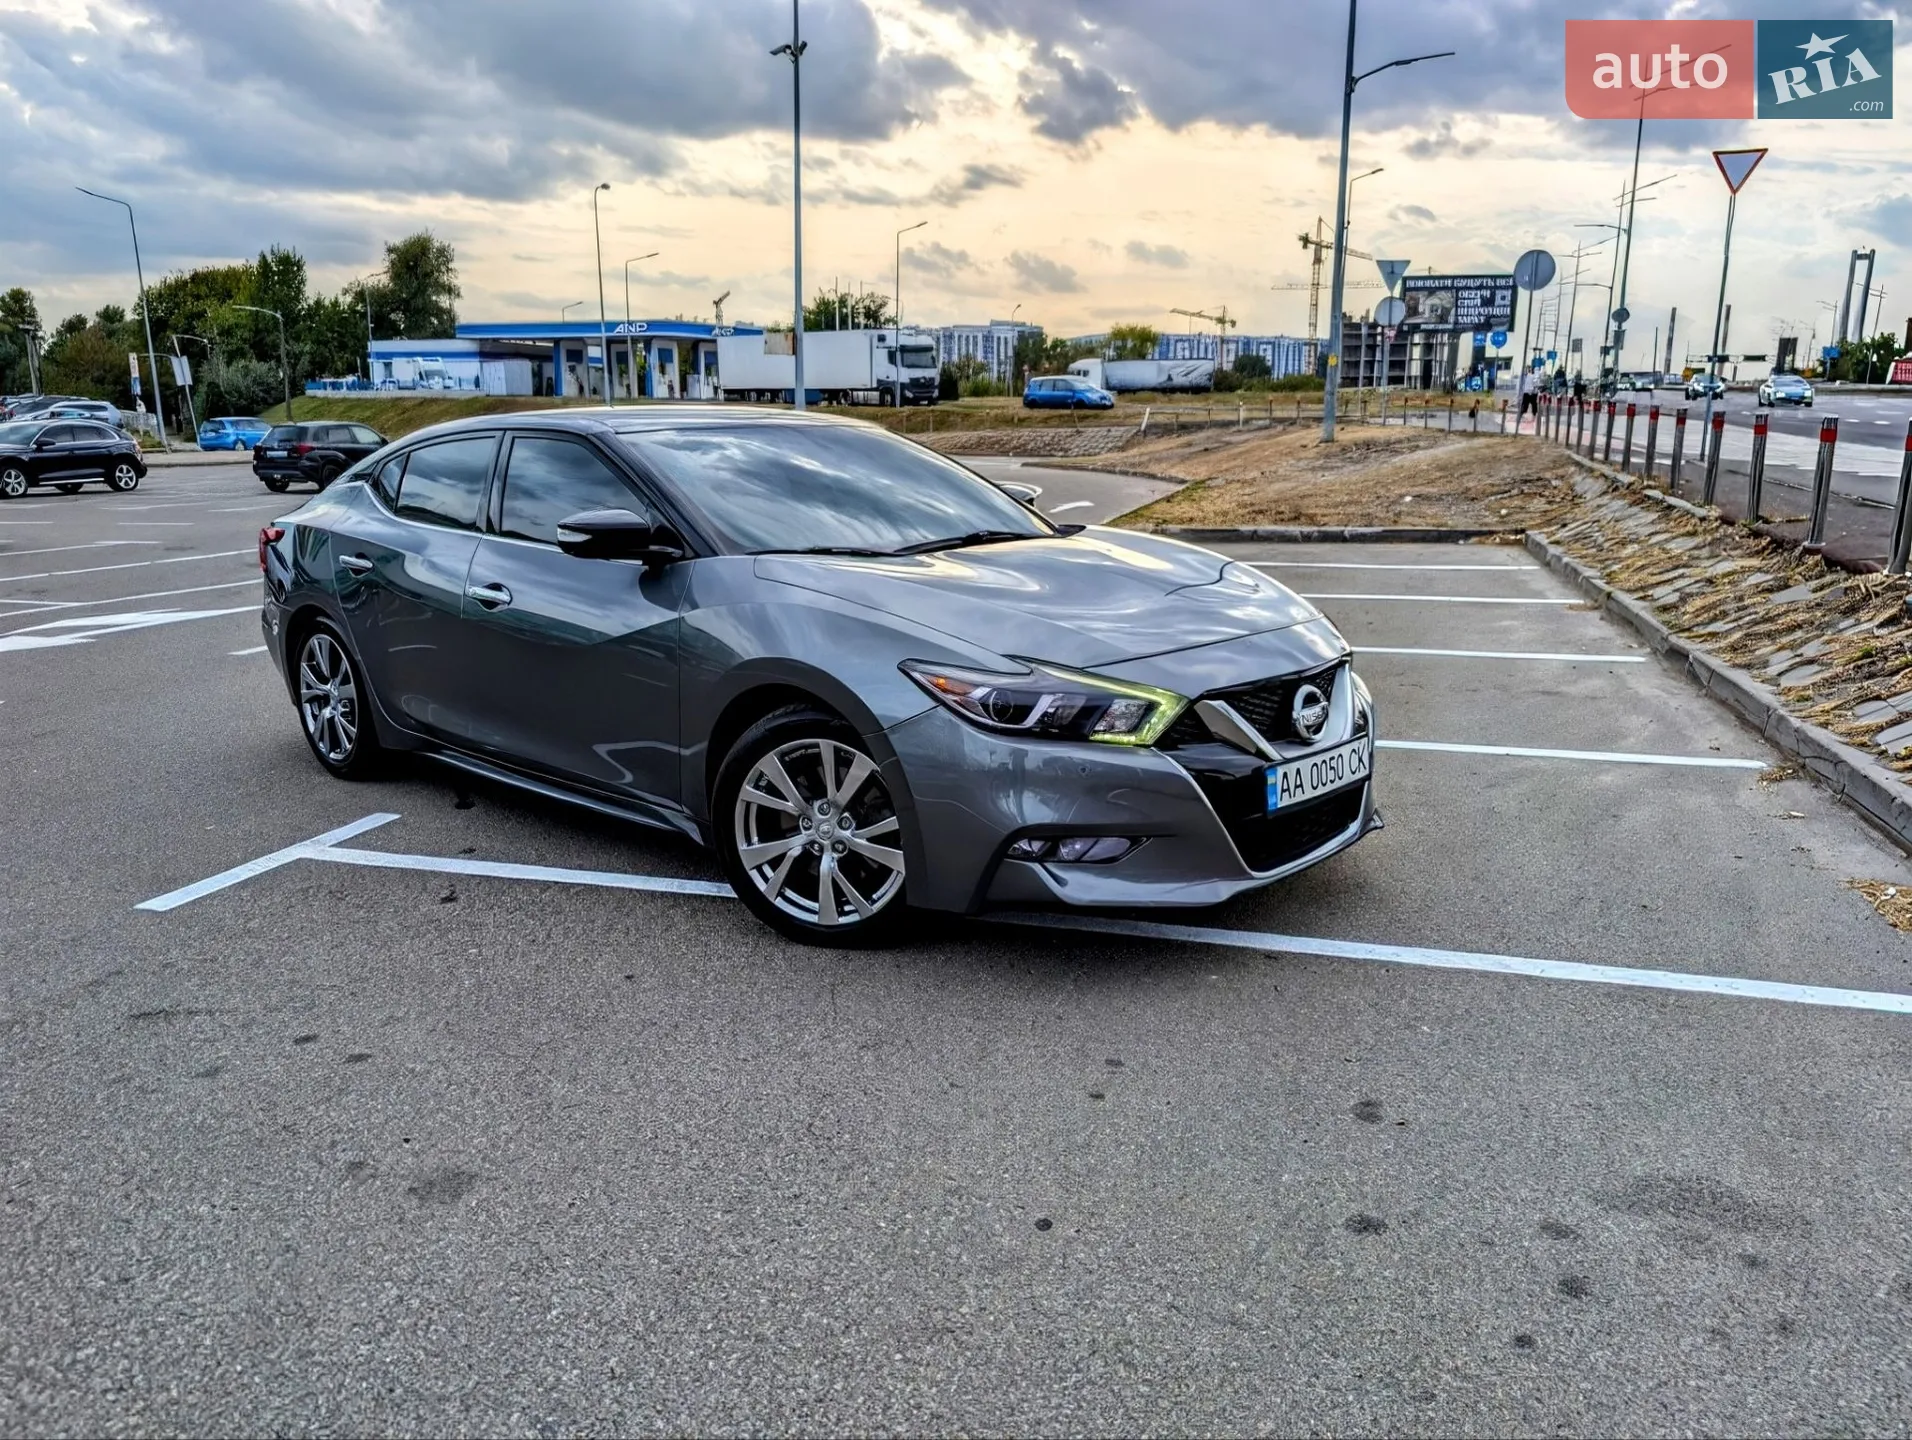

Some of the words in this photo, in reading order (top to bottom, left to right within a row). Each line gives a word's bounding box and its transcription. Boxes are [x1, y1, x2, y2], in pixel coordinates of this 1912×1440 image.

[1279, 767, 1305, 801] AA
[1310, 753, 1345, 790] 0050
[1348, 743, 1367, 775] CK
